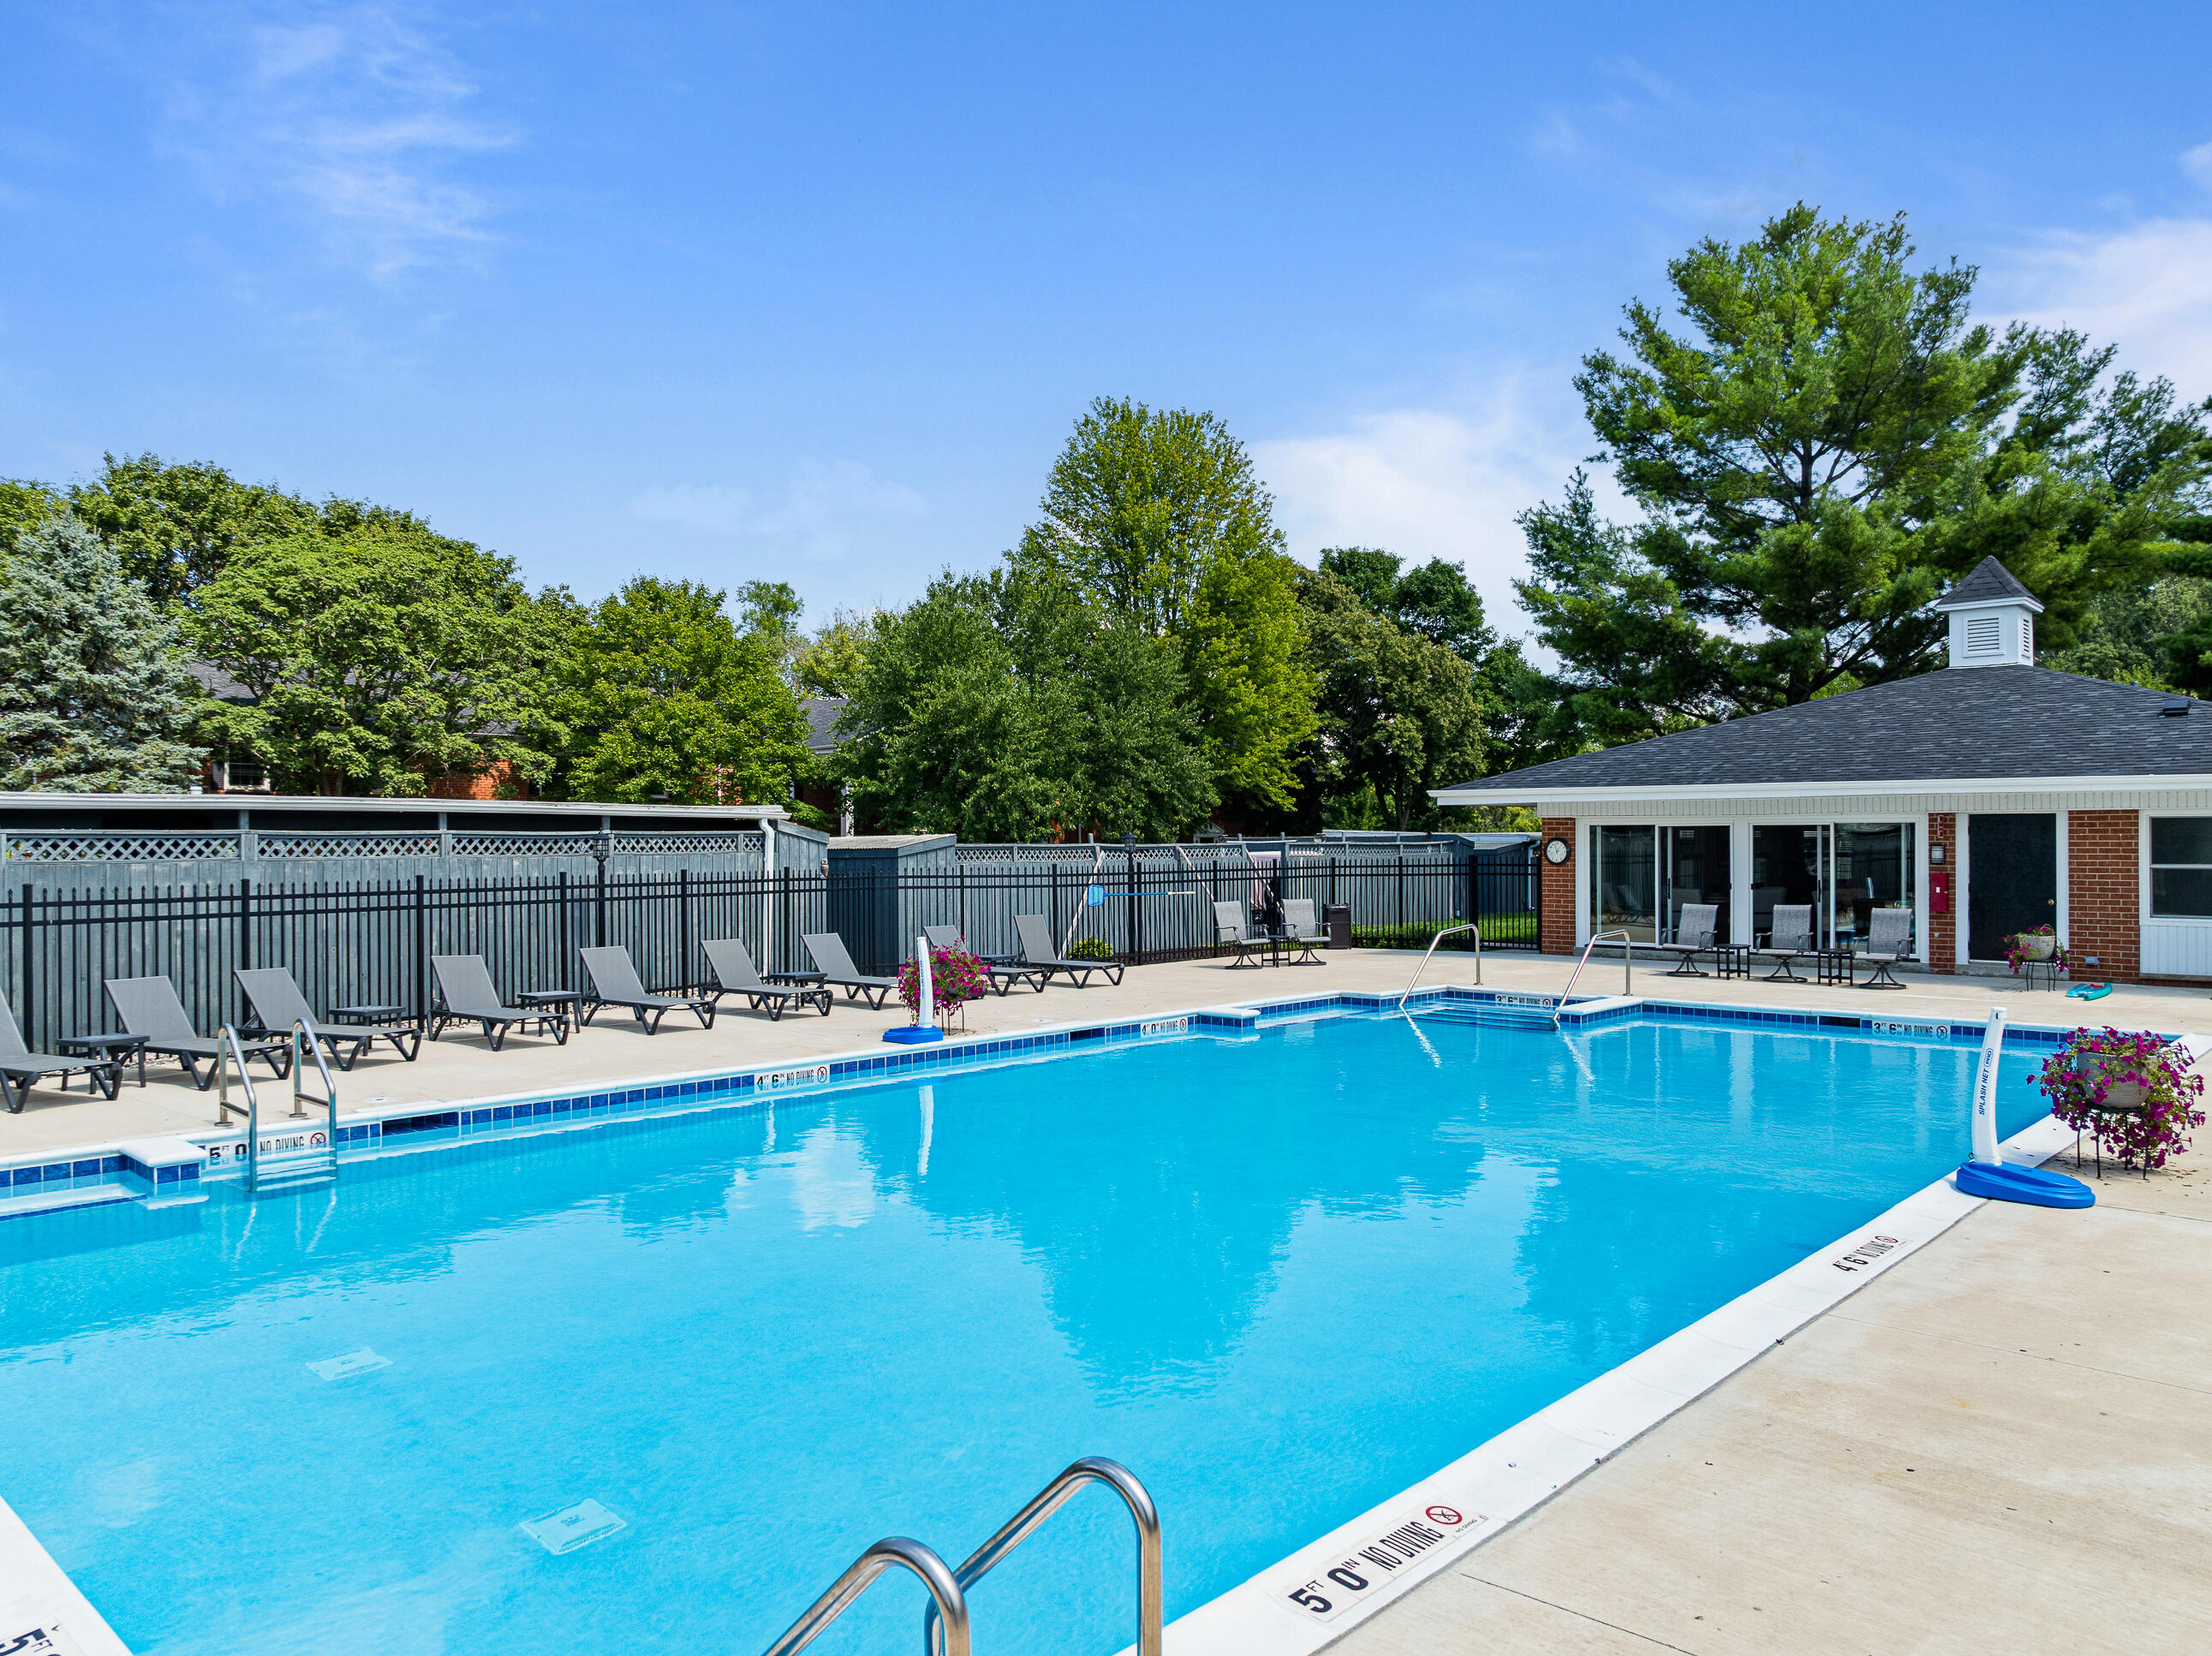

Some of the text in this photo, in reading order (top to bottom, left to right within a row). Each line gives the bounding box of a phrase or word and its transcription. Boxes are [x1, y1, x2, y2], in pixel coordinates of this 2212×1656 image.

[1874, 1022, 1881, 1032] 3
[1904, 1024, 1911, 1034] NO
[1914, 1026, 1933, 1034] DIVING
[756, 1075, 763, 1086] 4
[786, 1072, 794, 1083] NO
[796, 1069, 814, 1082] DIVING
[210, 1147, 221, 1160] 5
[260, 1140, 271, 1153] NO
[276, 1136, 304, 1151] DIVING
[1287, 1522, 1445, 1613] 5 FT 0 IN NO DIVING
